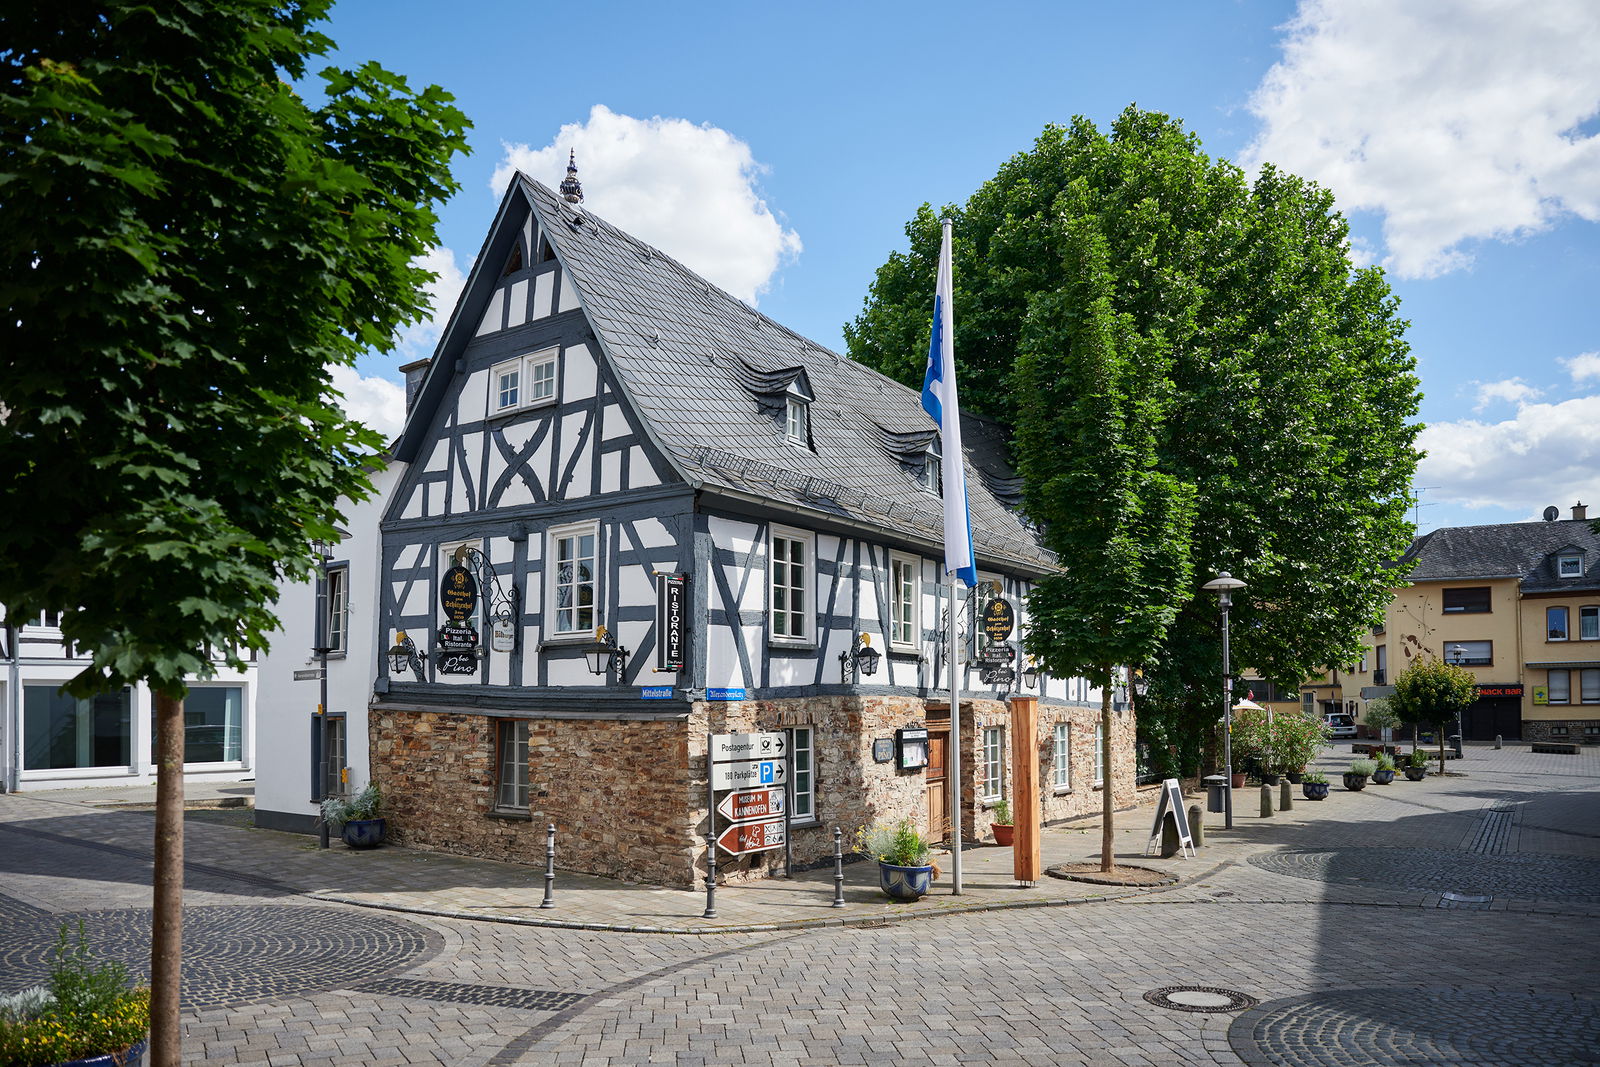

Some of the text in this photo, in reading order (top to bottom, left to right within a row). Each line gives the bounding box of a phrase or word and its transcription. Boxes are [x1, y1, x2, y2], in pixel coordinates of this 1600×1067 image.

[670, 587, 680, 657] RISTORANTE
[444, 640, 473, 648] Ristorante
[443, 657, 474, 672] Pino
[984, 671, 1013, 683] Pino
[642, 689, 672, 697] Mittelstraße
[721, 743, 755, 753] Postagentur
[734, 769, 758, 781] Parkplätze
[738, 794, 756, 804] MUSEUM
[734, 803, 767, 817] KANNENOFEN
